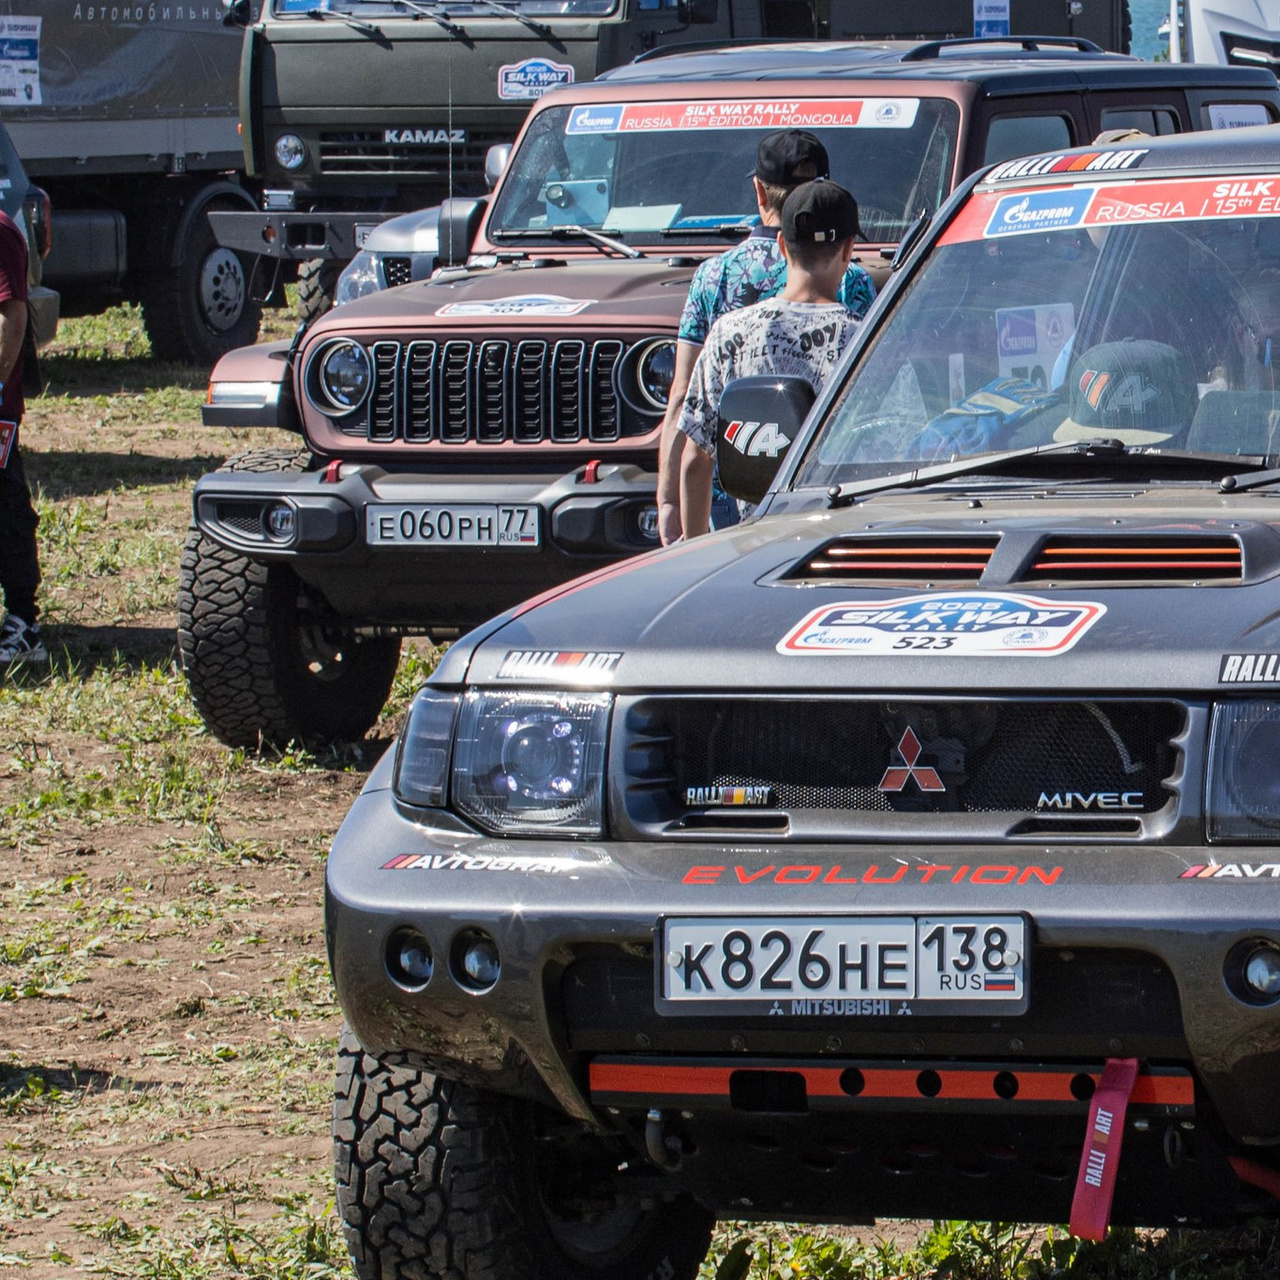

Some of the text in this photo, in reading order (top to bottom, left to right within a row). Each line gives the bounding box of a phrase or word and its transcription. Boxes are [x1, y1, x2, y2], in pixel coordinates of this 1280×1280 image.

[507, 73, 566, 82] SILK WAY
[686, 104, 799, 116] SILK WAY RALLY
[625, 118, 672, 129] RUSSIA
[709, 115, 762, 126] EDITION
[779, 113, 854, 125] MONGOLIA
[384, 130, 465, 143] KAMAZ
[1212, 181, 1276, 198] SILK
[1021, 206, 1074, 222] GAZPROM
[1095, 201, 1186, 222] RUSSIA
[1215, 197, 1252, 214] 15th
[502, 509, 528, 532] 77
[500, 533, 519, 541] RUS
[919, 602, 1003, 611] 2025
[831, 610, 1071, 625] SILK WAY
[893, 624, 988, 632] RALLY
[821, 637, 874, 645] GAZPROM
[892, 637, 954, 650] 523
[1037, 791, 1145, 809] MIVEC
[681, 864, 1065, 886] EVOLUTION
[922, 924, 1008, 973] 138
[940, 974, 982, 991] RUS
[791, 1000, 890, 1016] MITSUBISHI
